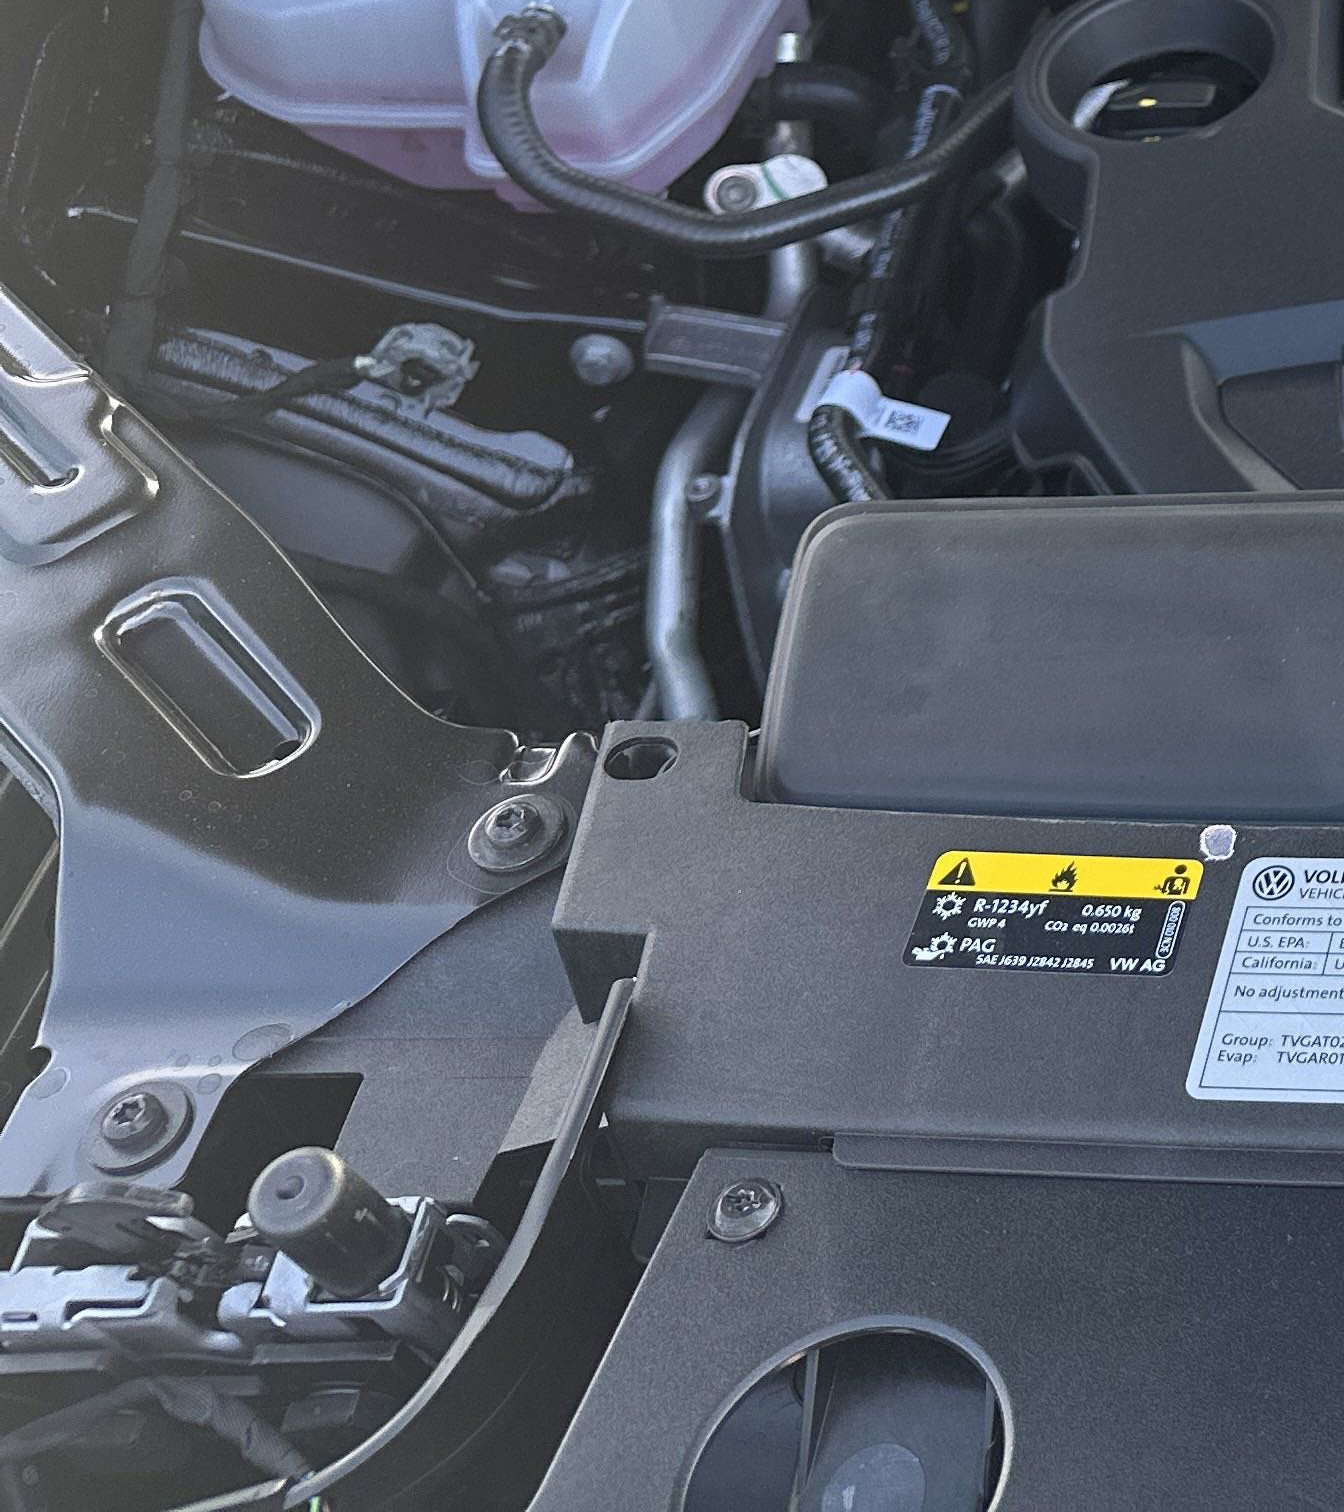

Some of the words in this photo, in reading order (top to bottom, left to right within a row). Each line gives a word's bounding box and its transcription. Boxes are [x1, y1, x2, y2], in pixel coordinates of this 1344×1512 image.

[973, 898, 1049, 919] R-1234yf
[1082, 905, 1122, 917] 0.650
[1124, 906, 1142, 921] kg
[968, 918, 997, 928] GWP
[997, 919, 1007, 928] 4
[1254, 913, 1323, 926] Conforms
[1328, 915, 1342, 926] to
[1072, 923, 1088, 934] eq
[959, 938, 997, 952] PAG
[1248, 936, 1273, 948] U.S.
[976, 954, 998, 965] SAE
[1110, 958, 1139, 971] VW
[1140, 959, 1166, 972] AG
[1242, 956, 1317, 970] California:
[1234, 985, 1255, 997] No
[1222, 1034, 1273, 1049] Group:
[1217, 1050, 1257, 1066] Evap:
